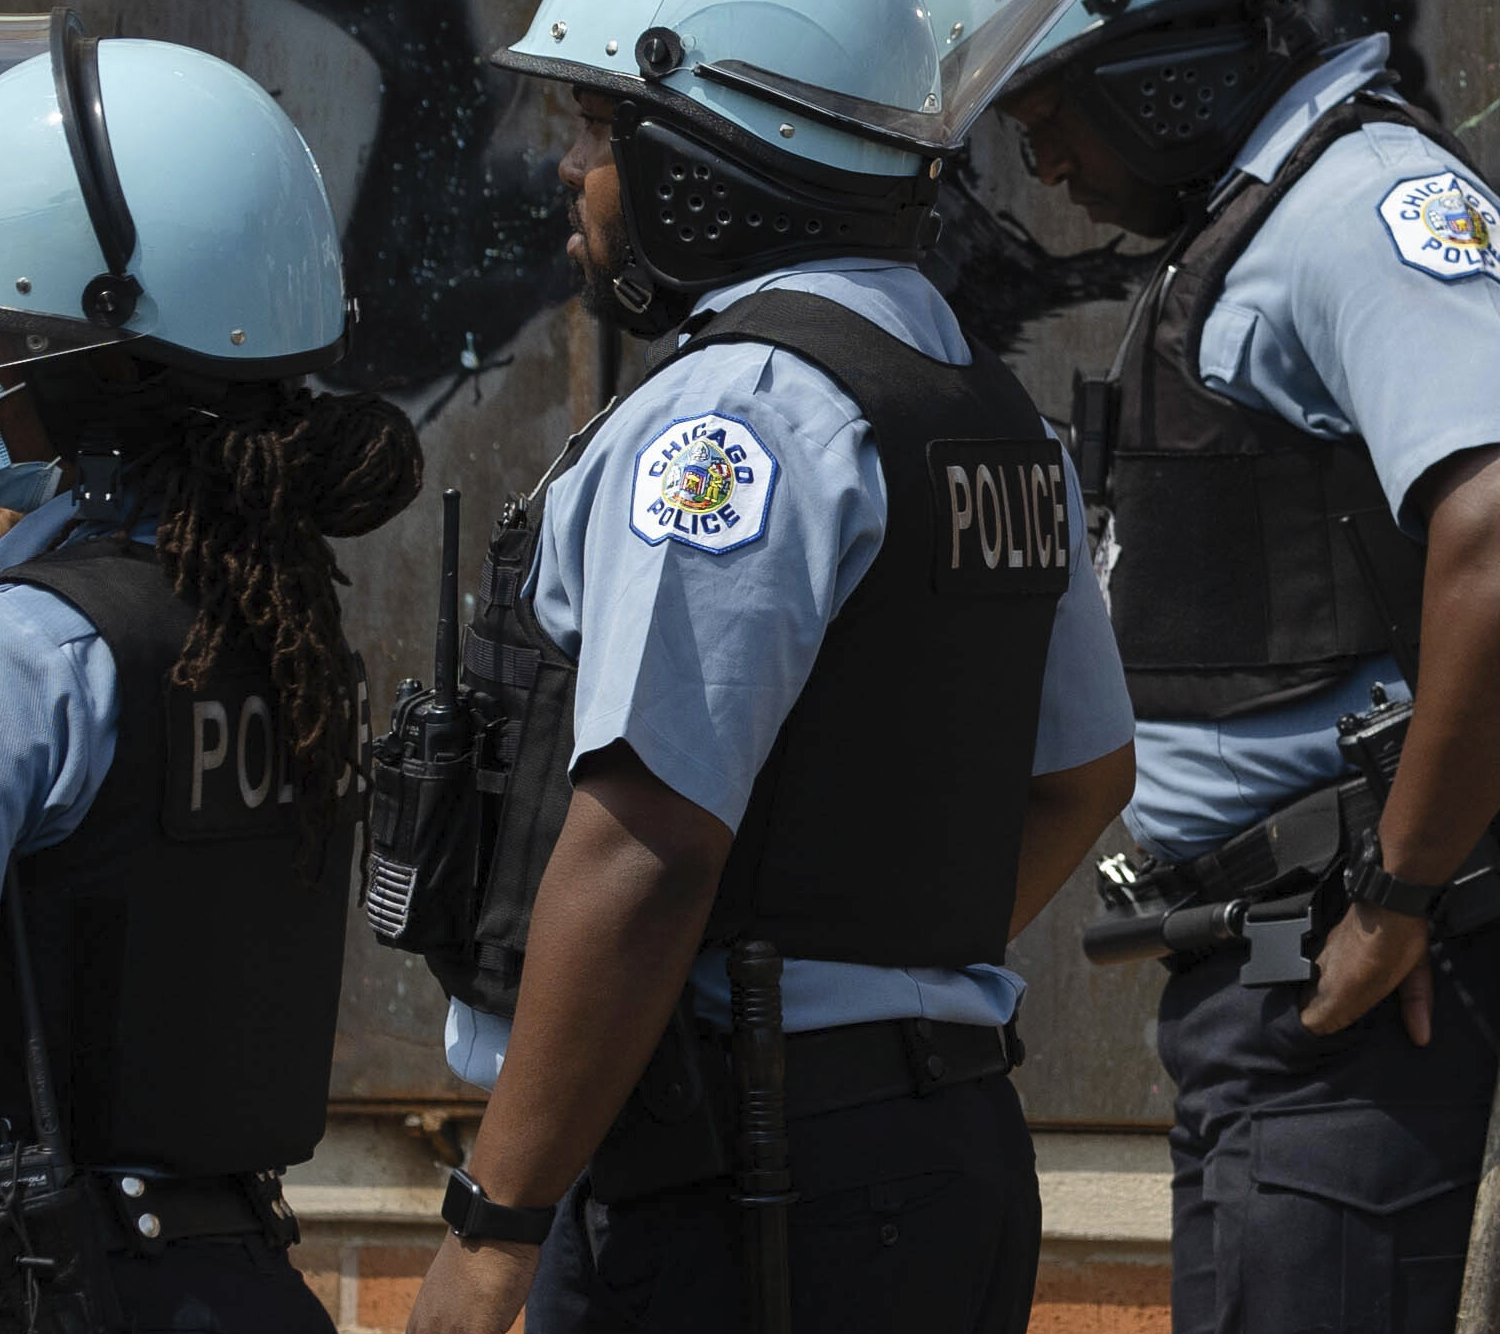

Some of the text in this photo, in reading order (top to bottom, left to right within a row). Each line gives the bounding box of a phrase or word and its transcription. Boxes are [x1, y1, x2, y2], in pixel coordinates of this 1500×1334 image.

[1400, 178, 1497, 226] CHICAGO
[648, 422, 755, 484] CHICAGO
[646, 497, 741, 535] POLICE
[946, 464, 1067, 569] POLICE
